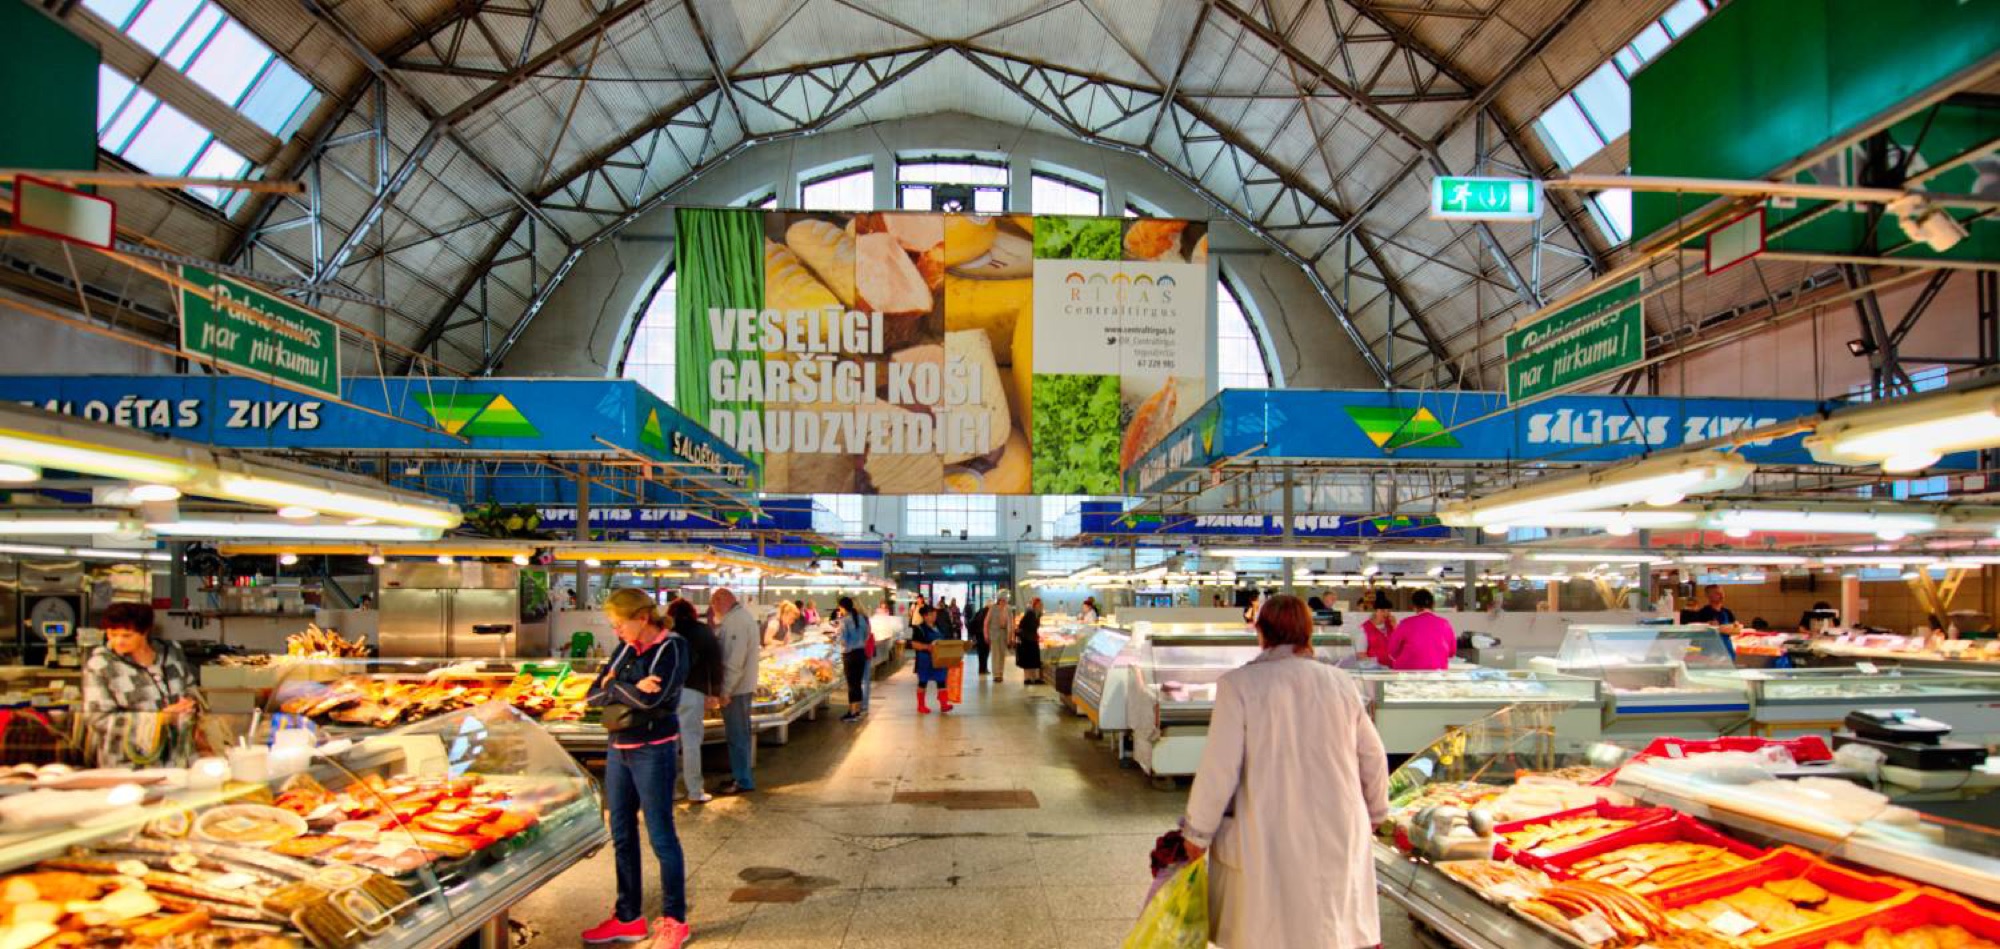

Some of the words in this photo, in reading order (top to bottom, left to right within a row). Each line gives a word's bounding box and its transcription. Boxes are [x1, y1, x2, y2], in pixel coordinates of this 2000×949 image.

[202, 322, 240, 350] par
[709, 304, 884, 354] VESELĪGI
[709, 353, 876, 405] GARŠĪGI
[888, 354, 982, 405] KOŠI
[1519, 363, 1545, 396] par
[226, 399, 322, 430] ZIVIS
[709, 406, 991, 455] DAUDZVEIDĪGI
[1527, 408, 1670, 445] SĀLĪTAS
